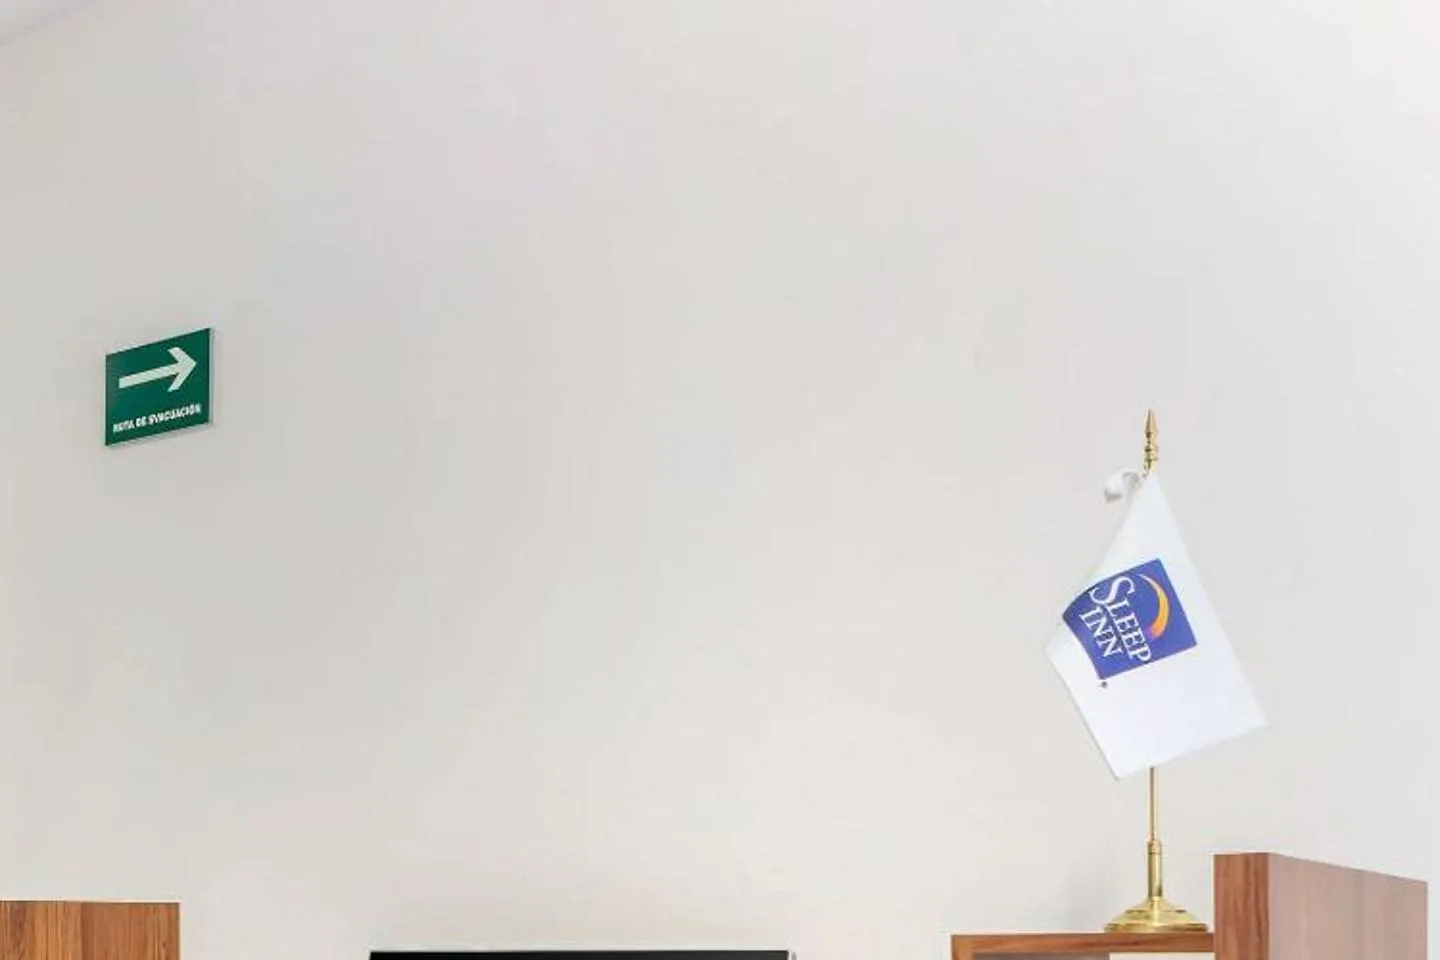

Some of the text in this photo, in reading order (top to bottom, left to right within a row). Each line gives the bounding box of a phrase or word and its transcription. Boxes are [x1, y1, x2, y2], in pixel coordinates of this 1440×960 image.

[135, 416, 148, 428] DE
[1078, 606, 1125, 658] INN
[1089, 575, 1152, 663] SLEEP
